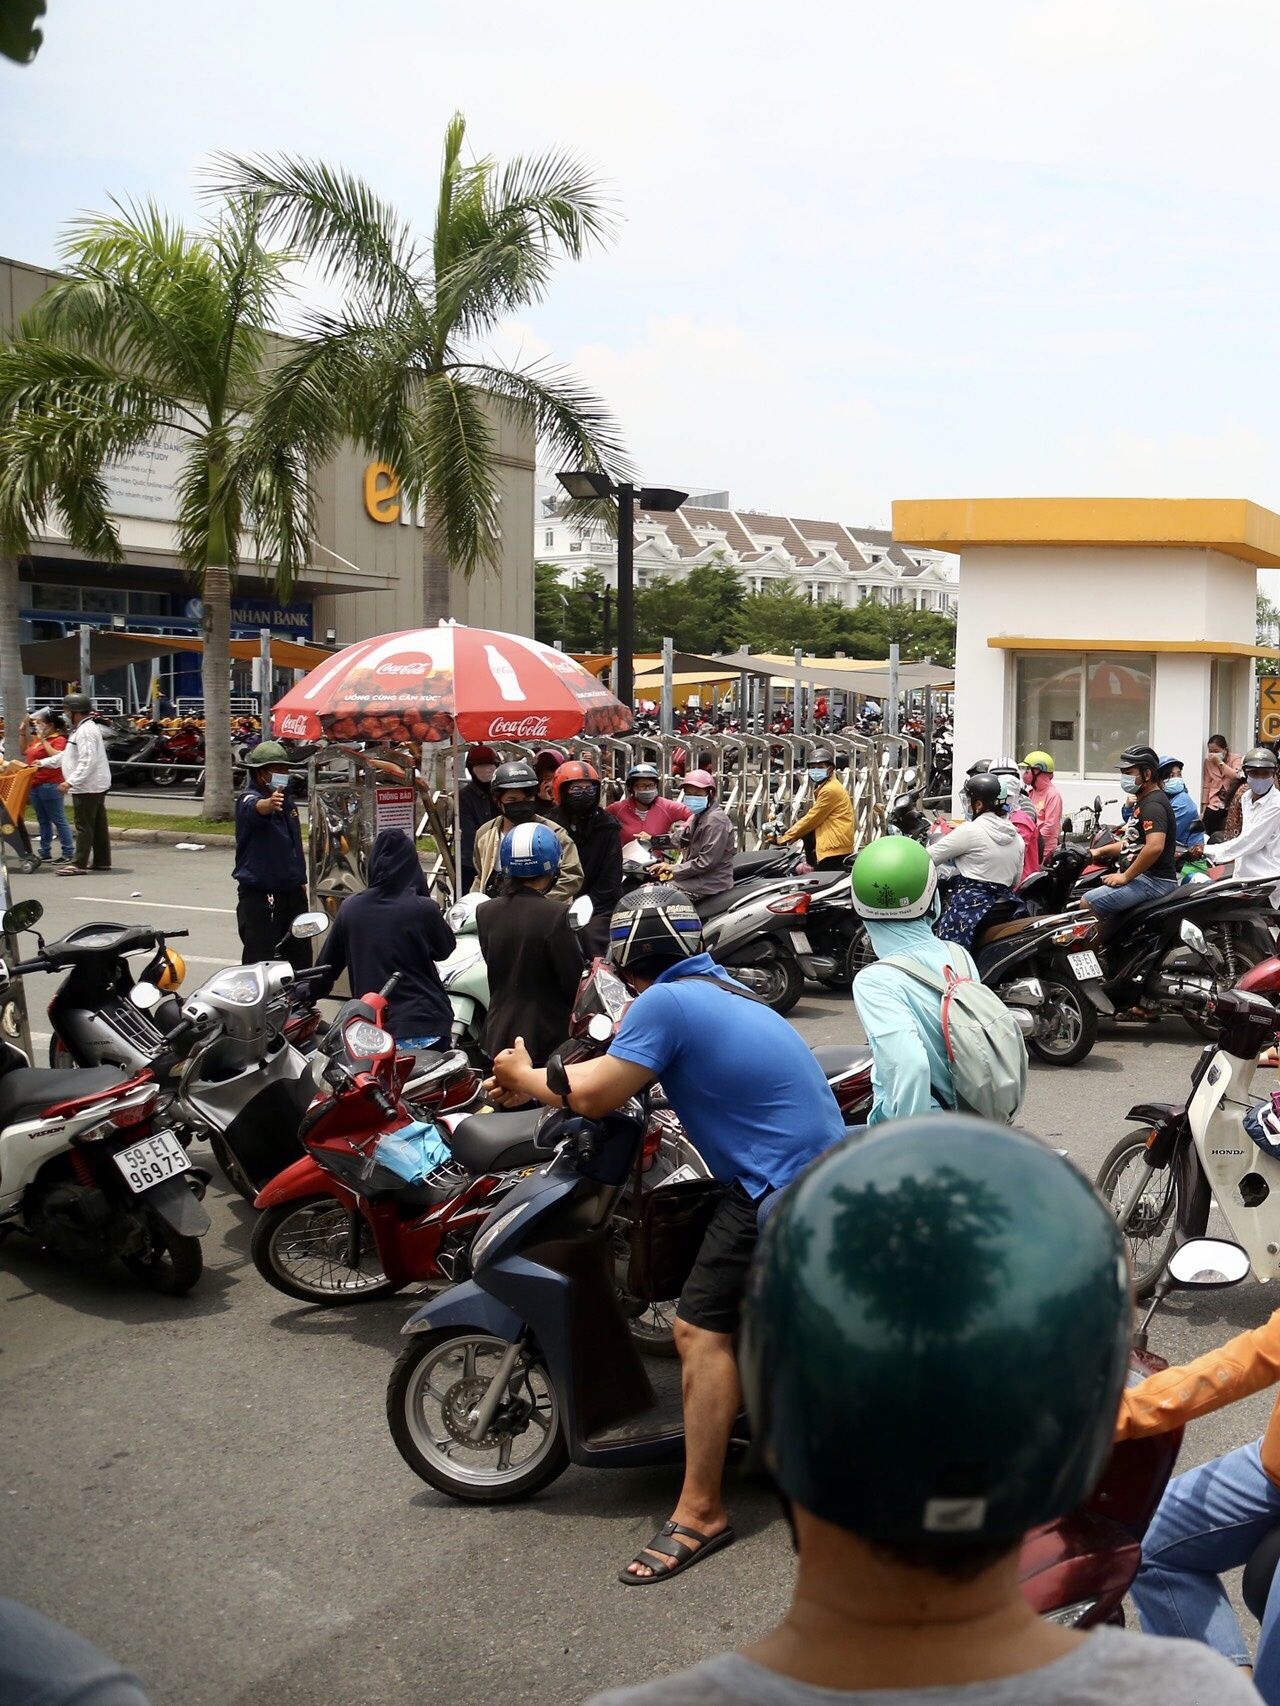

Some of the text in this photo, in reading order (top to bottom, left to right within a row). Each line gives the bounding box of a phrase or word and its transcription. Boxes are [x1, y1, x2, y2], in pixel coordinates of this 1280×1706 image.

[273, 611, 309, 626] BANK
[488, 715, 551, 738] Coca-Cola
[28, 1125, 66, 1140] VISION
[124, 1137, 170, 1169] 59-E1
[130, 1151, 186, 1189] 969.75
